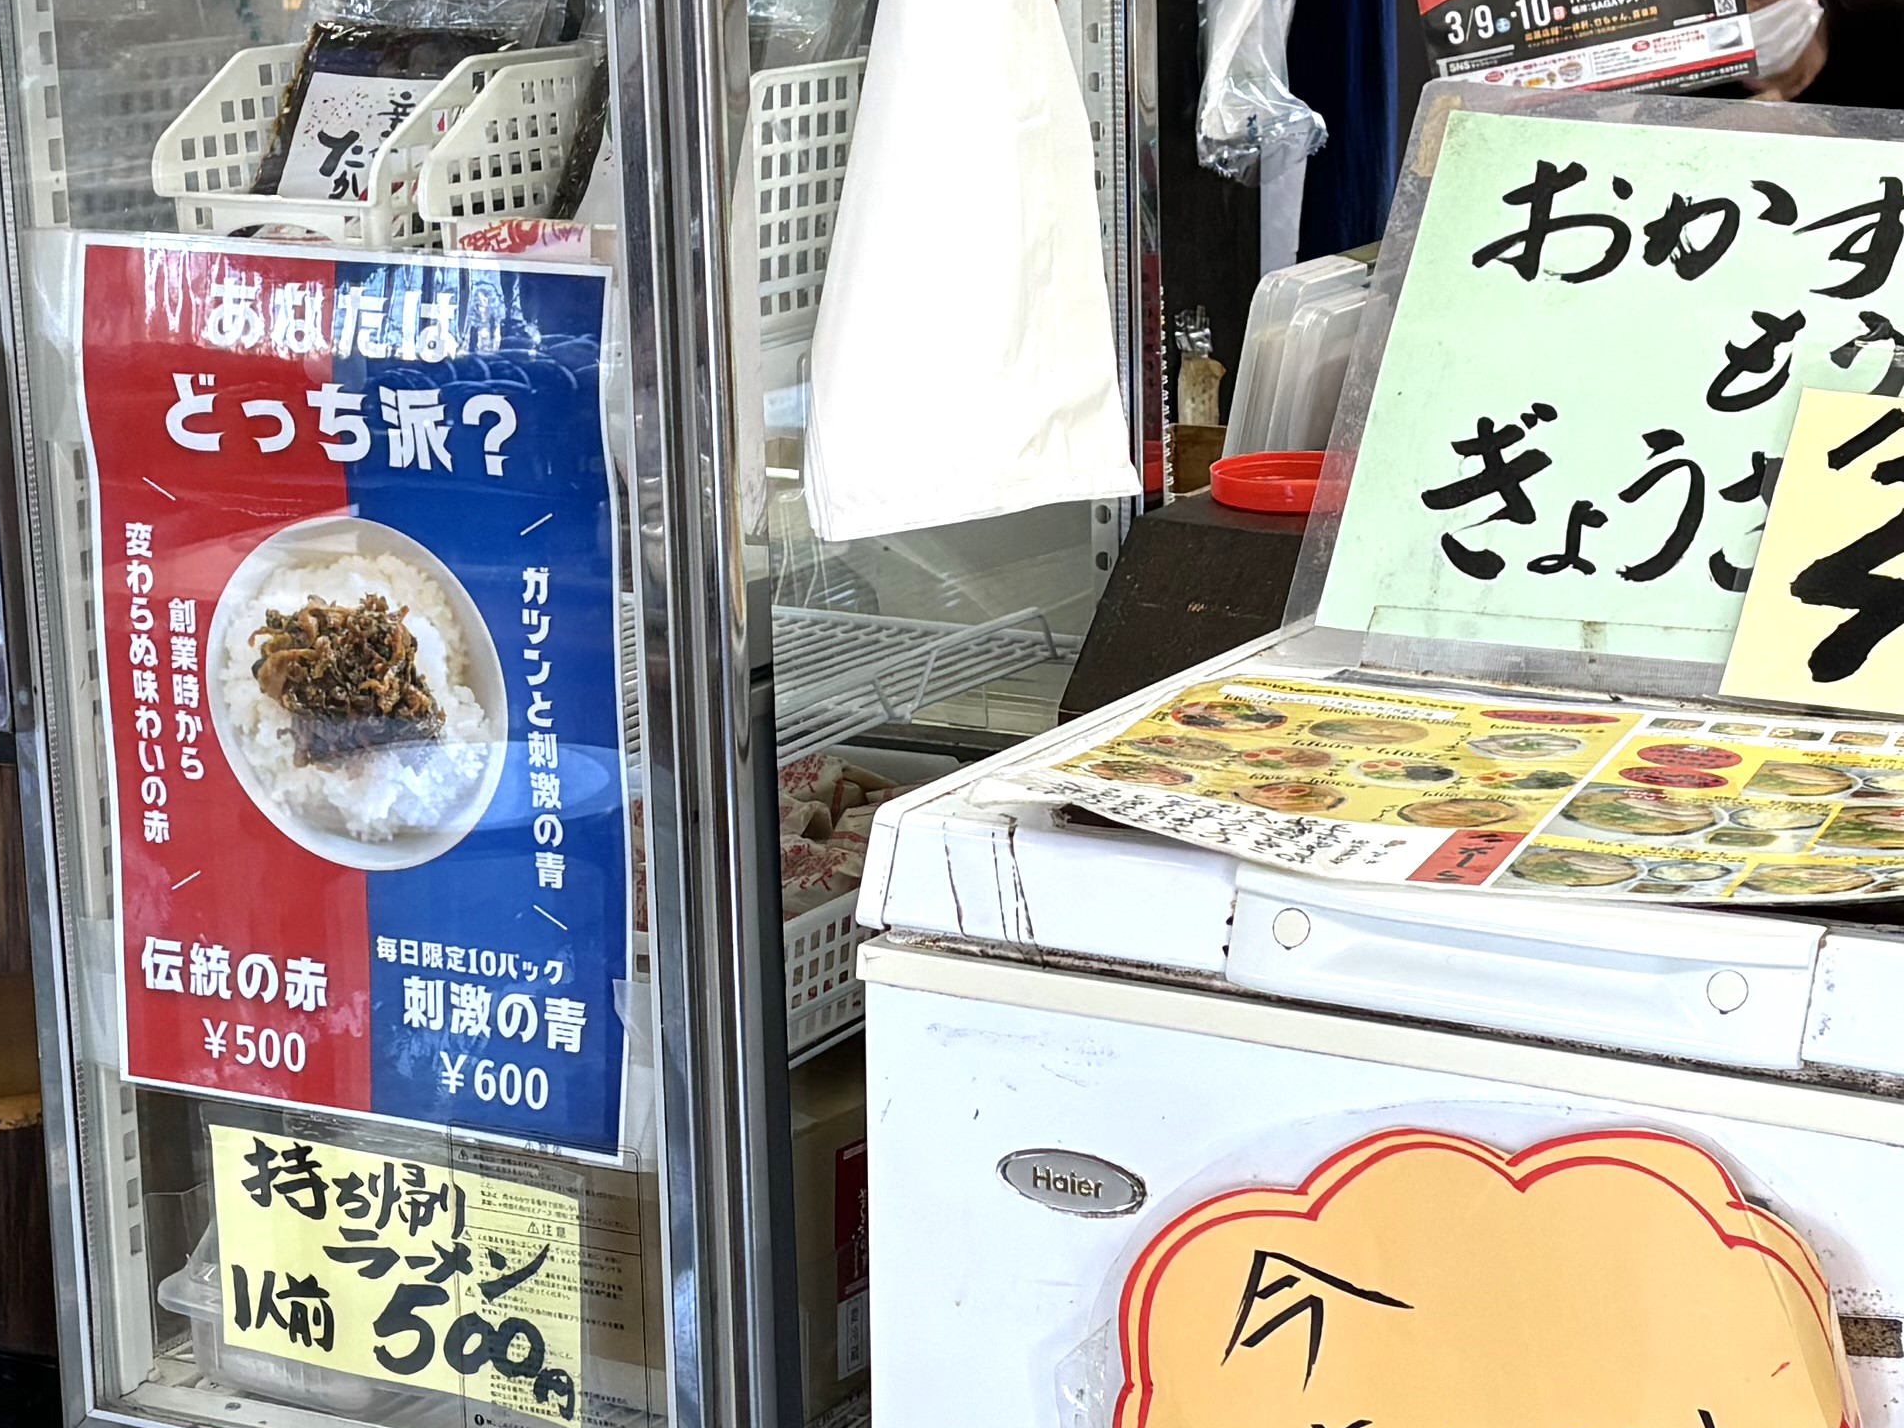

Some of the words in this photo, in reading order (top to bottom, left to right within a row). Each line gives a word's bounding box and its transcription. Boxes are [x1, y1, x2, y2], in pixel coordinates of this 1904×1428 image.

[124, 521, 171, 844] 変わらぬ味わいの赤
[168, 597, 206, 781] 創業時から
[140, 935, 328, 1013] 伝統の赤
[202, 1018, 307, 1073] ¥500
[402, 975, 588, 1053] 刺激の青
[440, 1051, 549, 1111] ¥600
[242, 1136, 468, 1240] 持ち帰り
[1032, 1164, 1103, 1199] Haier
[322, 1226, 552, 1302] ラーメン
[1220, 1249, 1416, 1392] 今
